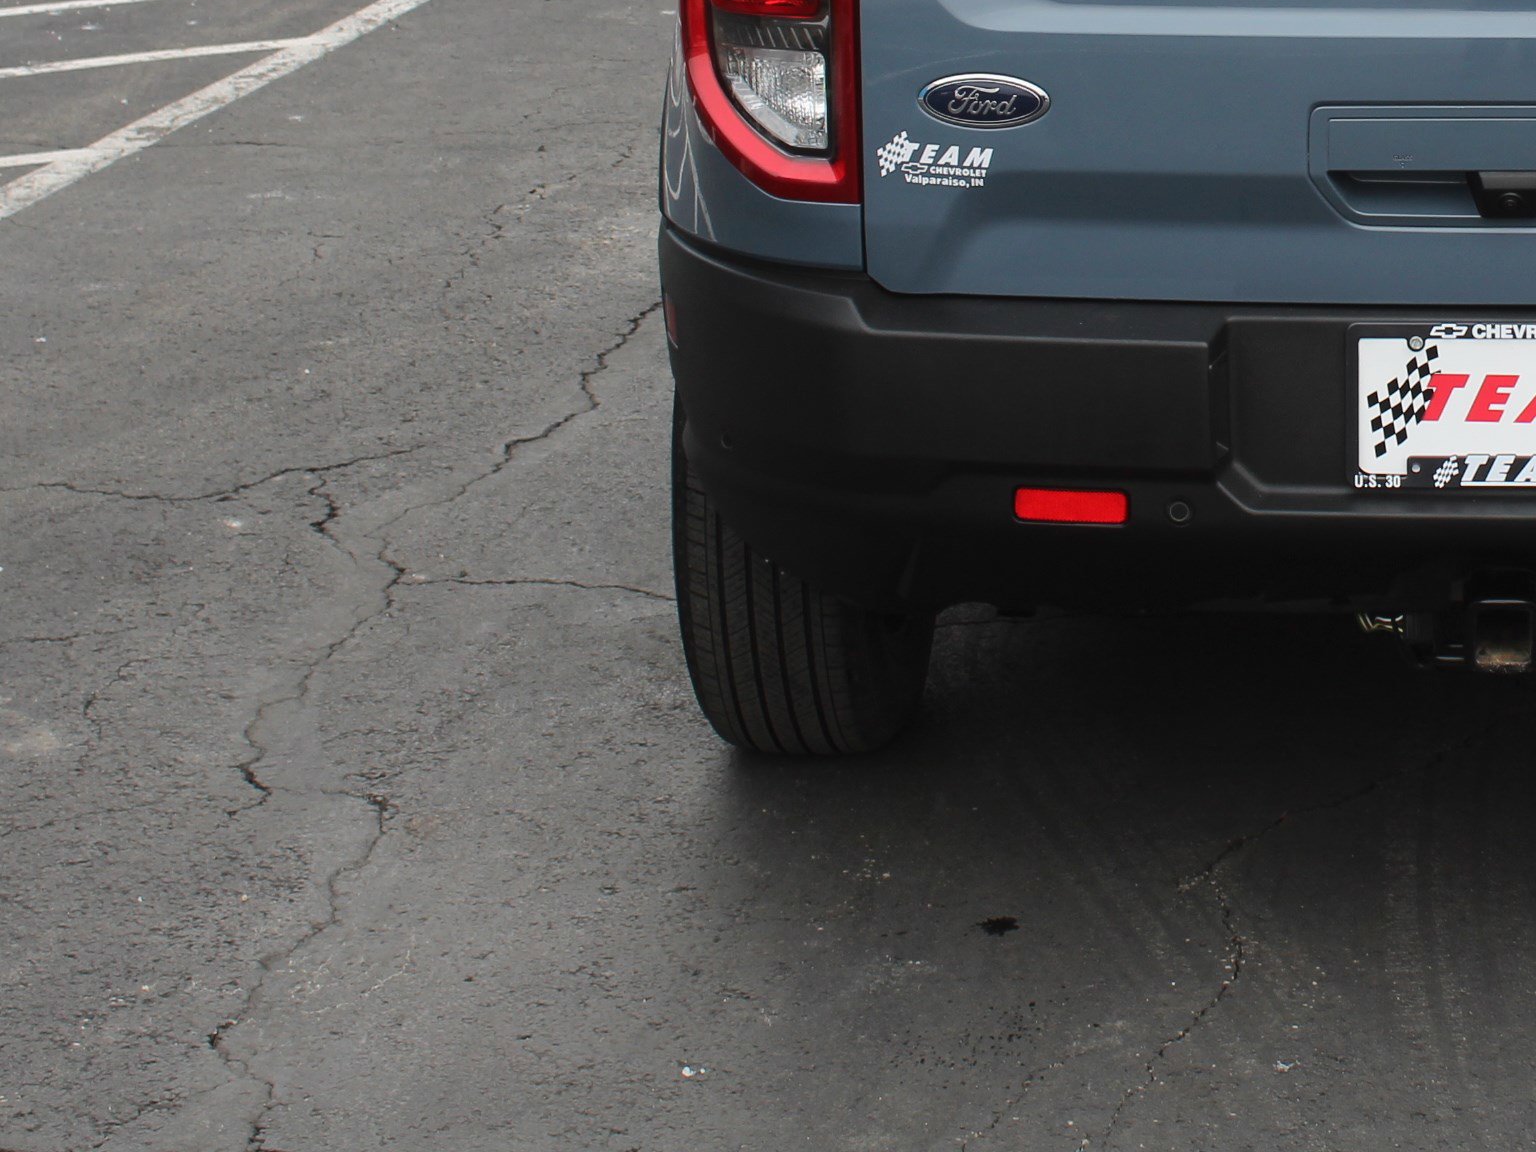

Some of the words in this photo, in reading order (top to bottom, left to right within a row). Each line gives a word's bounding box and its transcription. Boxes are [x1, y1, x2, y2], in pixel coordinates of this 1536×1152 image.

[947, 85, 1017, 116] Ford
[902, 141, 994, 168] TEAM
[929, 165, 987, 178] CHEVROLET
[904, 174, 970, 188] Valparaiso,
[971, 178, 984, 187] IN
[1354, 474, 1381, 488] U.S.
[1384, 475, 1401, 488] 30
